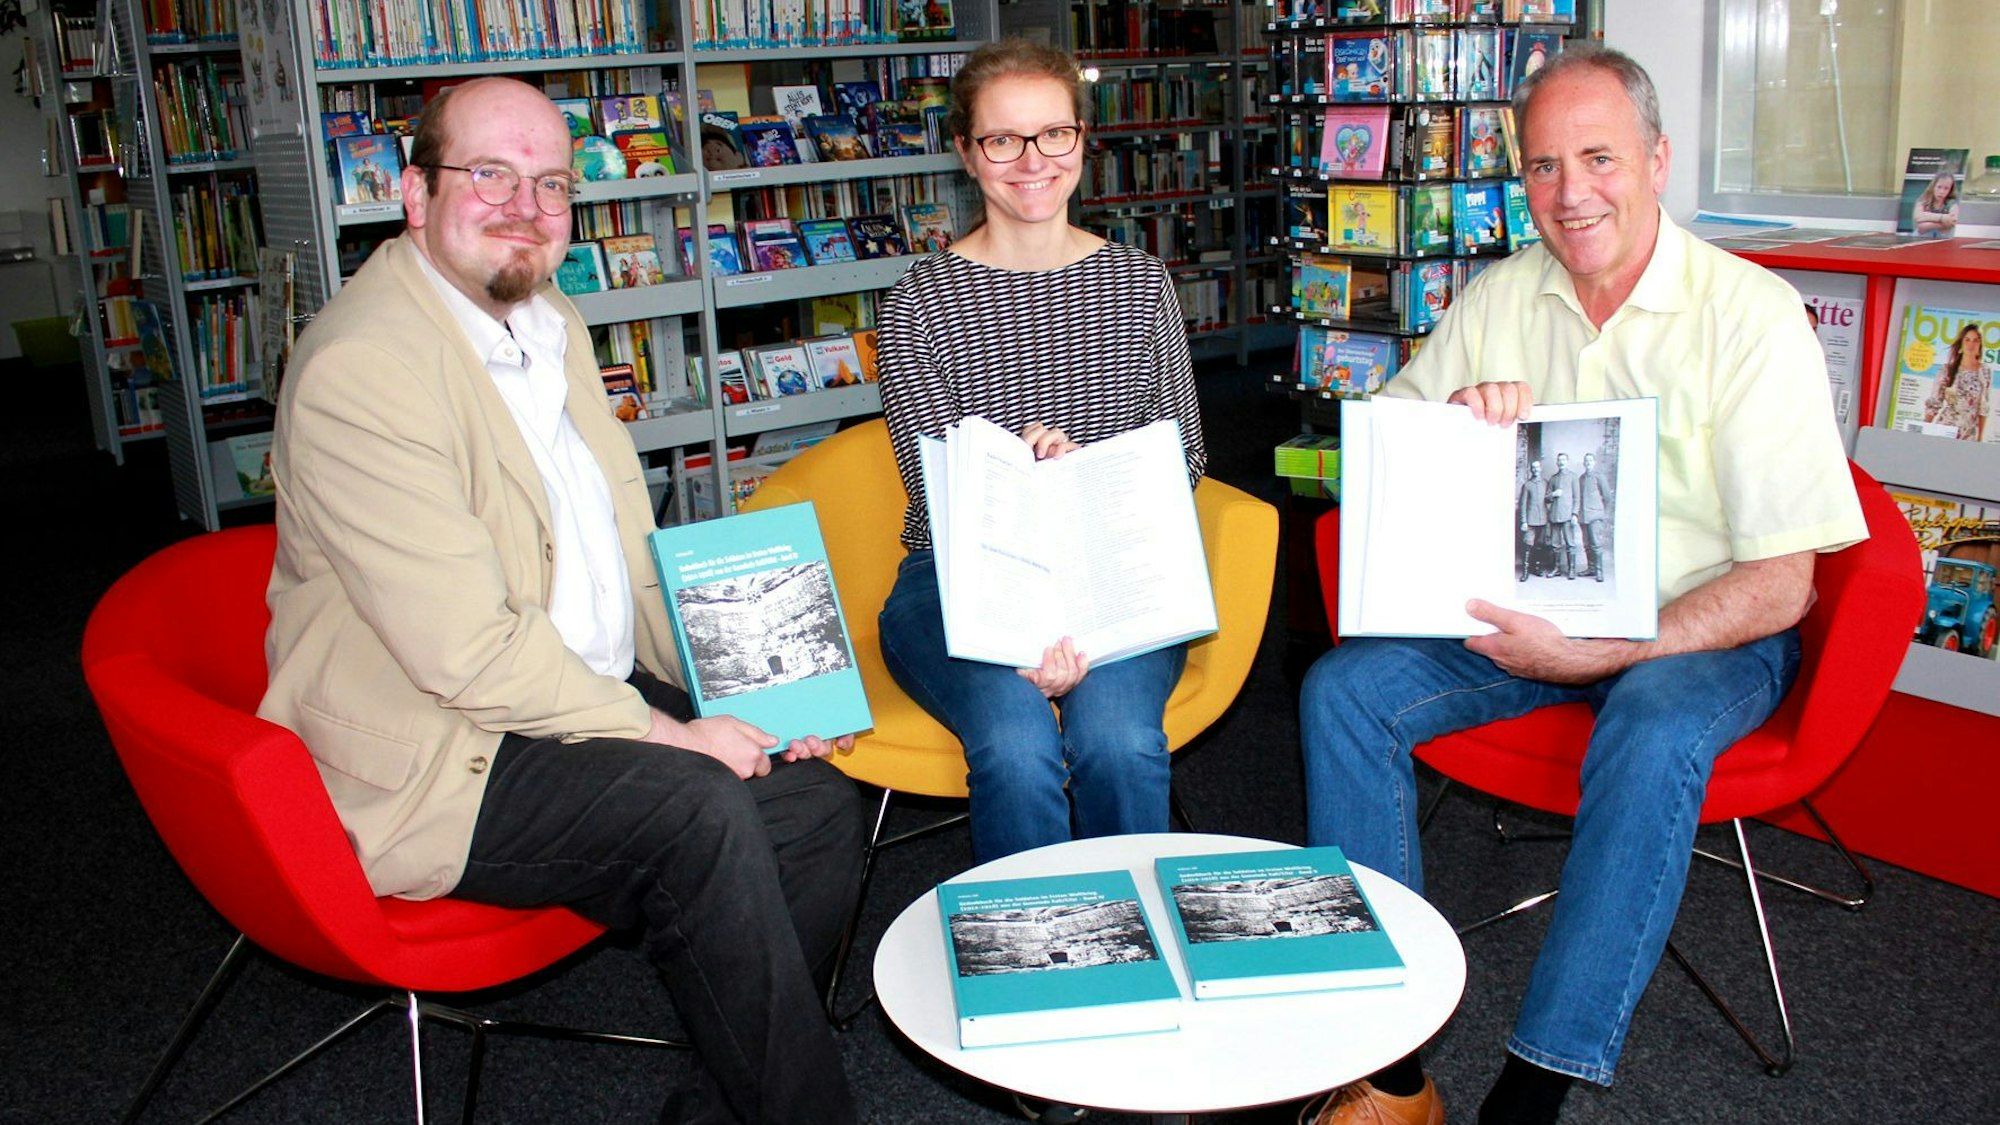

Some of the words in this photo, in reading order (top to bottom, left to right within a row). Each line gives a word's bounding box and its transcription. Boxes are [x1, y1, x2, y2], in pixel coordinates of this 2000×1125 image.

[786, 90, 805, 103] ALLES
[702, 113, 739, 131] OBEN
[823, 344, 849, 353] Vulkane
[774, 354, 793, 363] Geld
